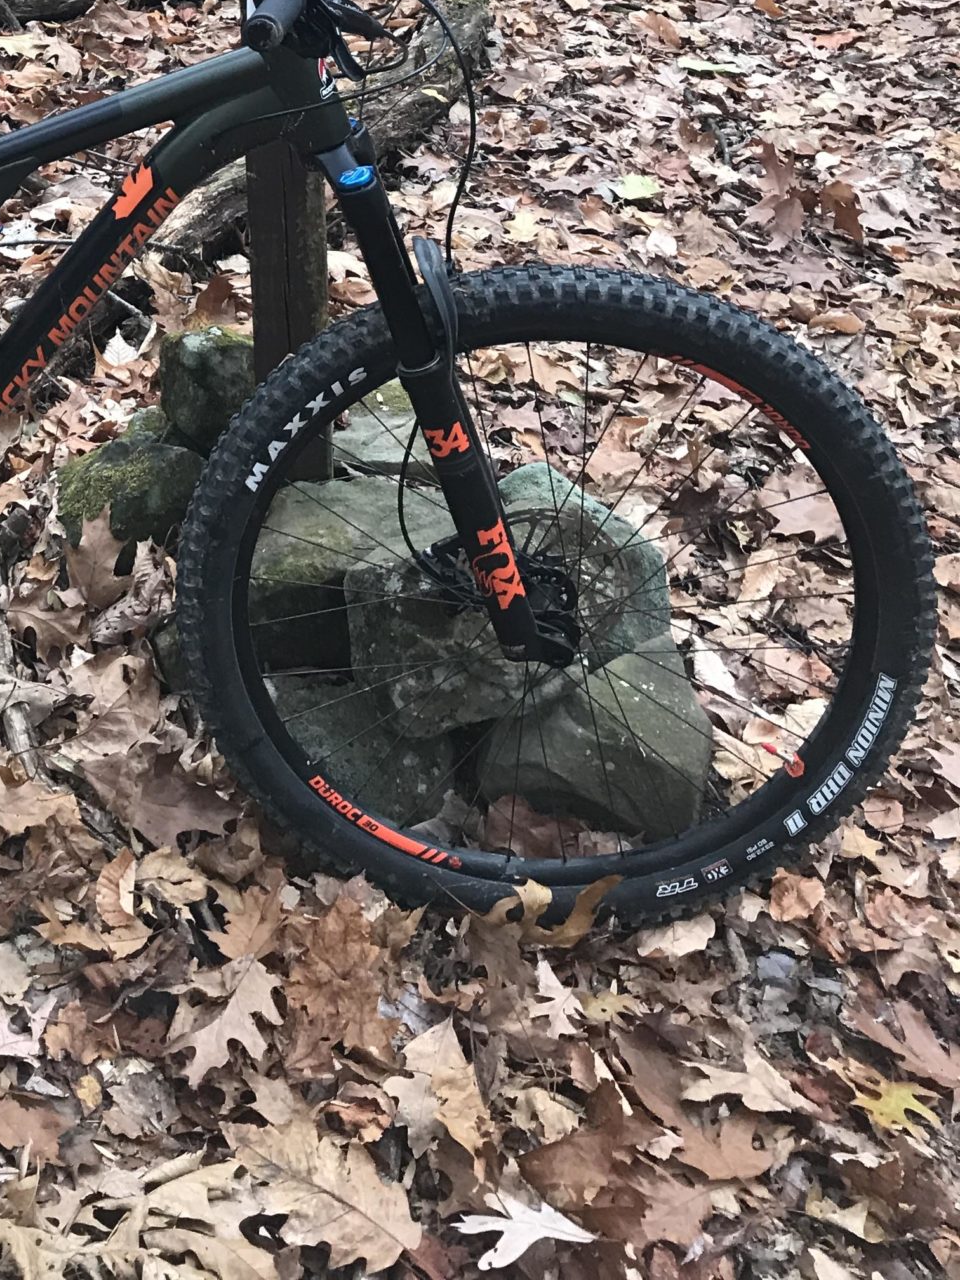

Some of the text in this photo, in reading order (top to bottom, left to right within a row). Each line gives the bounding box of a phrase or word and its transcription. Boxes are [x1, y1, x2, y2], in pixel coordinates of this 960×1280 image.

[48, 187, 182, 347] MOUNTAIN
[244, 367, 368, 493] MAXXIS
[424, 420, 470, 458] 34
[472, 517, 527, 610] FOX
[846, 672, 898, 768] MINION
[807, 761, 855, 816] DHR
